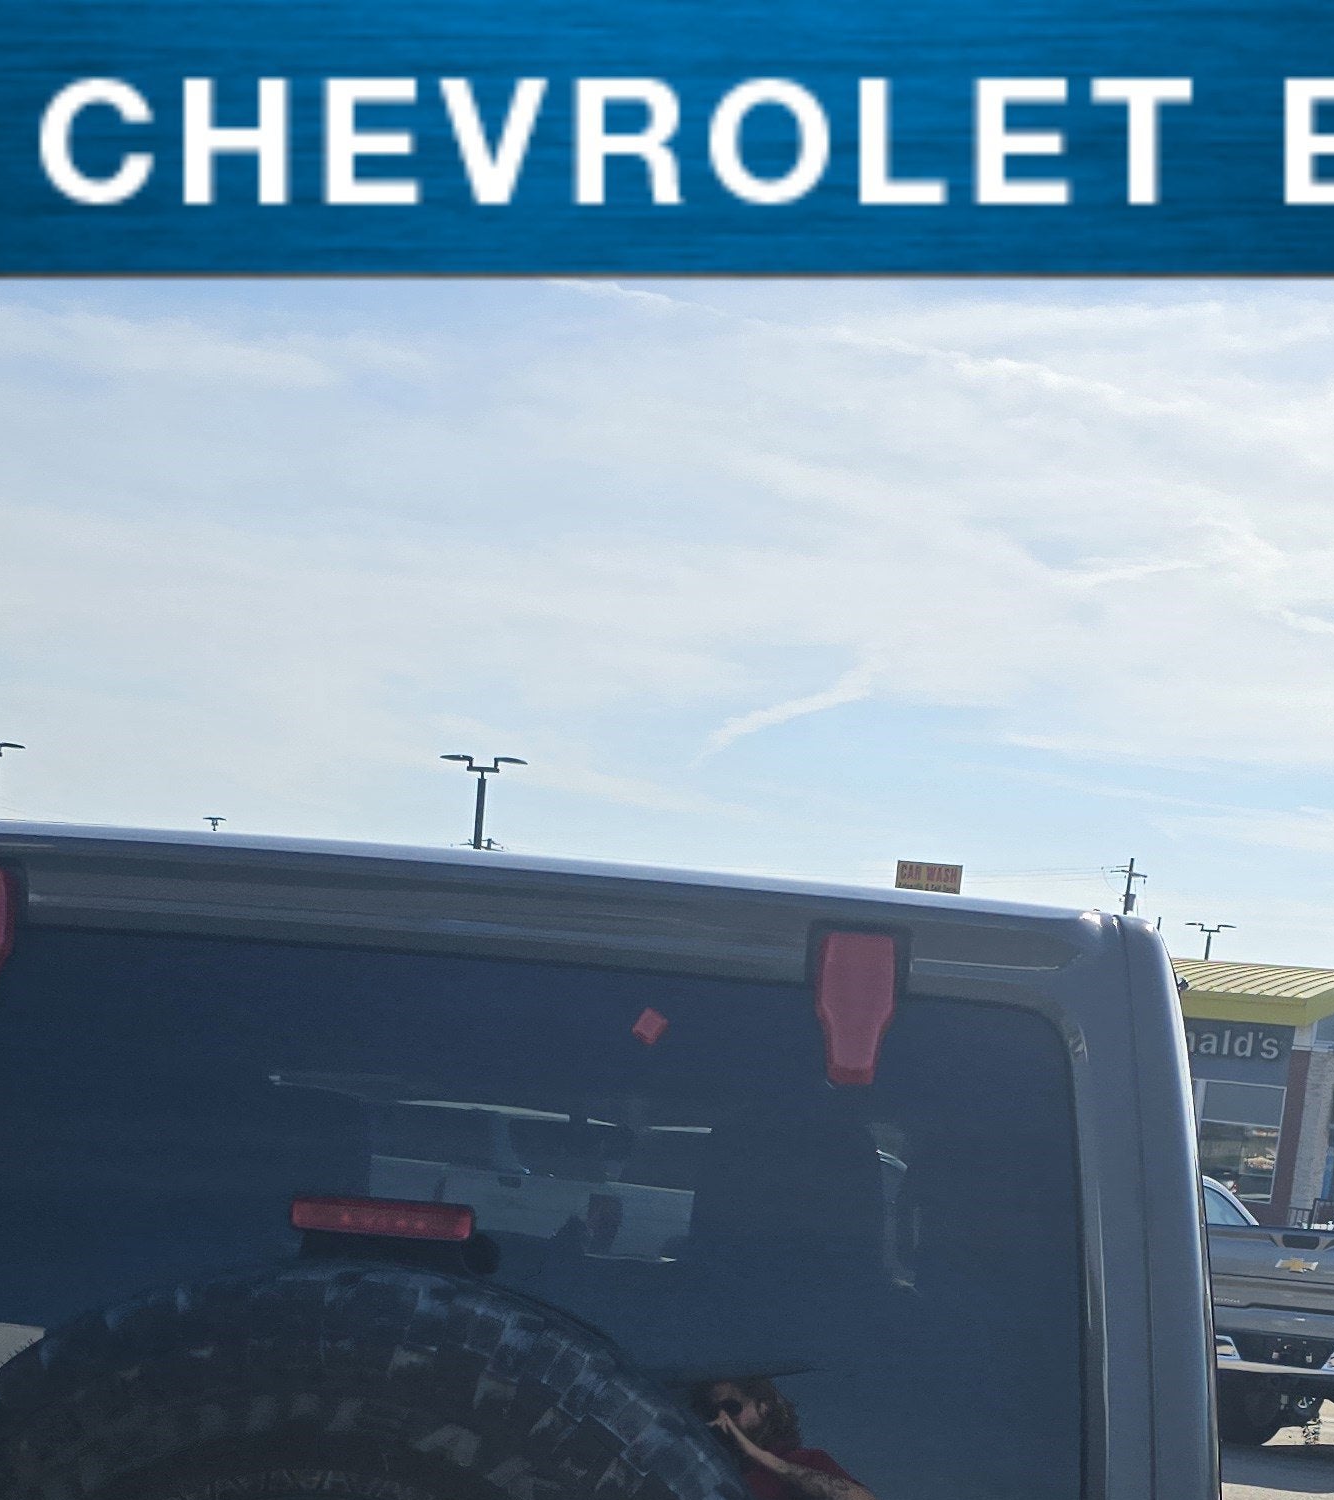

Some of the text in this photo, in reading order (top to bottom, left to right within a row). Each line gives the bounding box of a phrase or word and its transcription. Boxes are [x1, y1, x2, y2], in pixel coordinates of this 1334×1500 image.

[899, 864, 958, 883] CAR WASH
[1186, 1029, 1279, 1060] nald's
